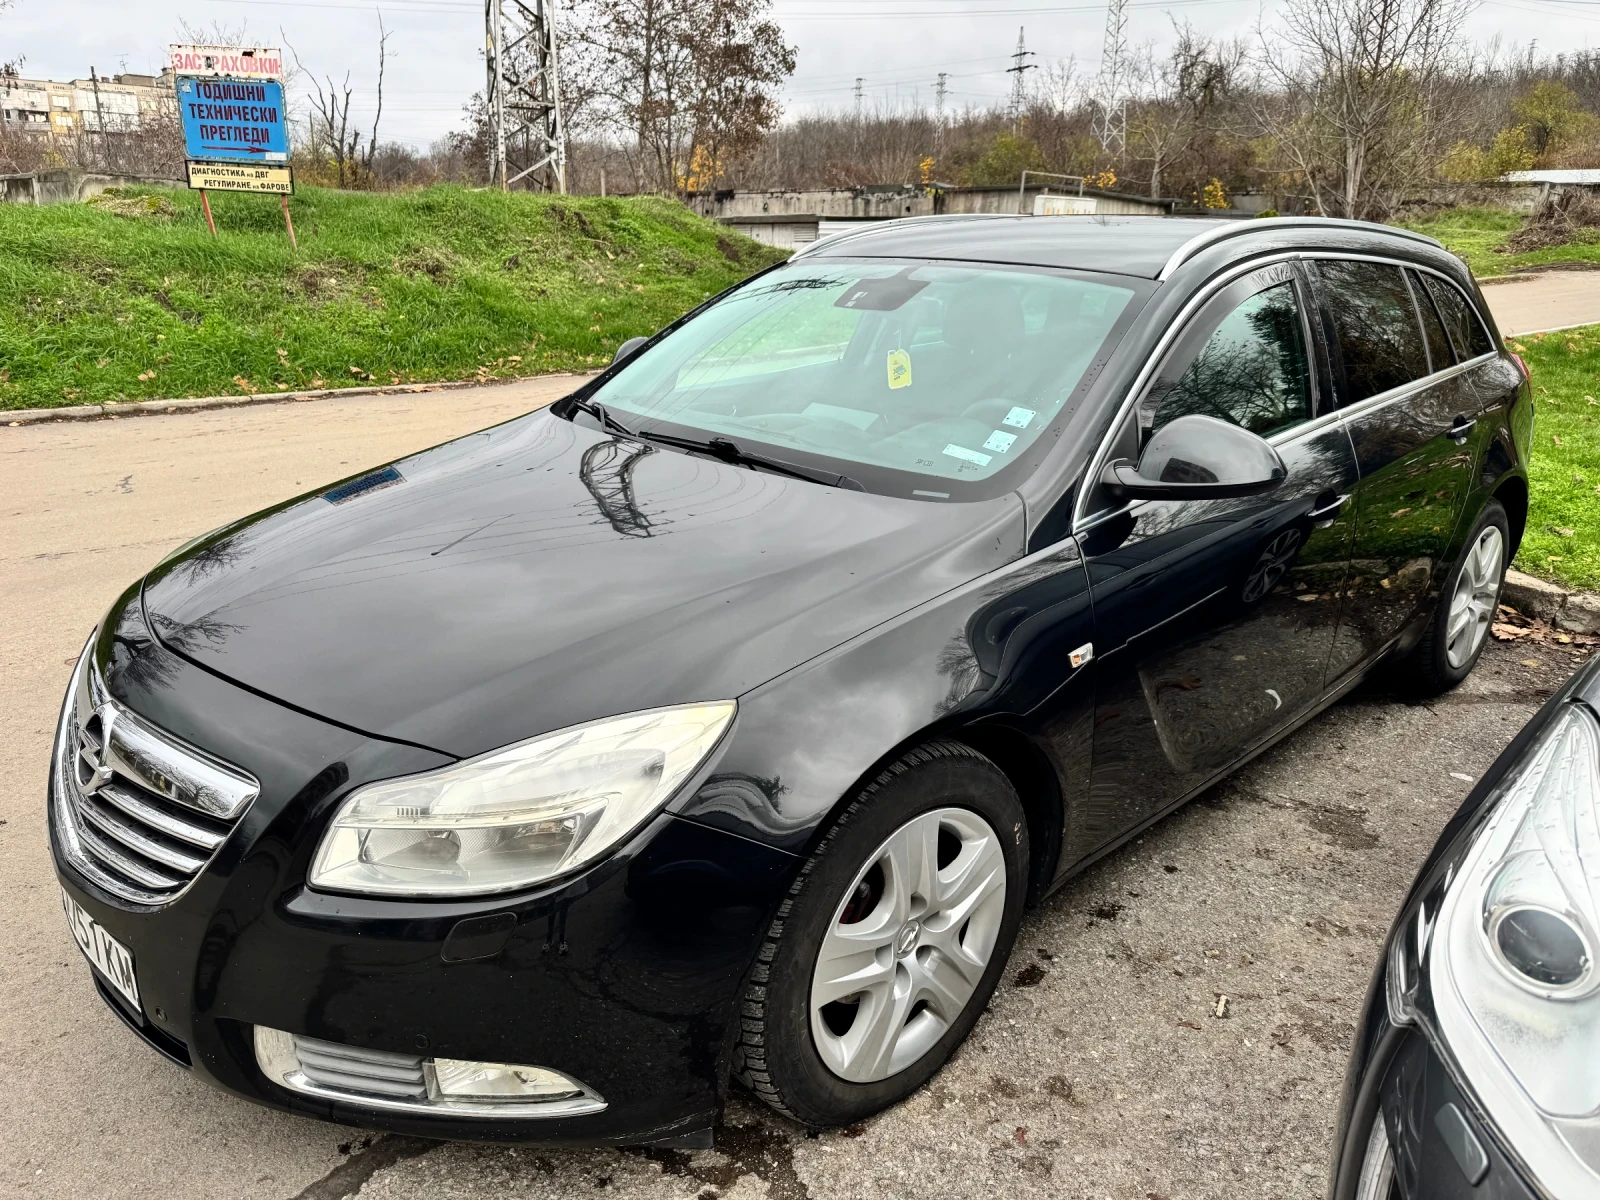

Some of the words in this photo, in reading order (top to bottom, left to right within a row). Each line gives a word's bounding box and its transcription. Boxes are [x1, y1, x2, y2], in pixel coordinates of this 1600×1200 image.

[195, 82, 266, 102] ГОДИШНИ
[188, 103, 278, 123] ТЕХНИЧЕСКИ
[200, 124, 270, 146] ПРЕГЛЕДИ
[191, 167, 246, 177] ДИАГНОСТИКА
[255, 170, 270, 178] ДВГ
[203, 179, 252, 189] РЕГУЛИРАНЕ
[260, 182, 290, 192] ФАРОВЕ
